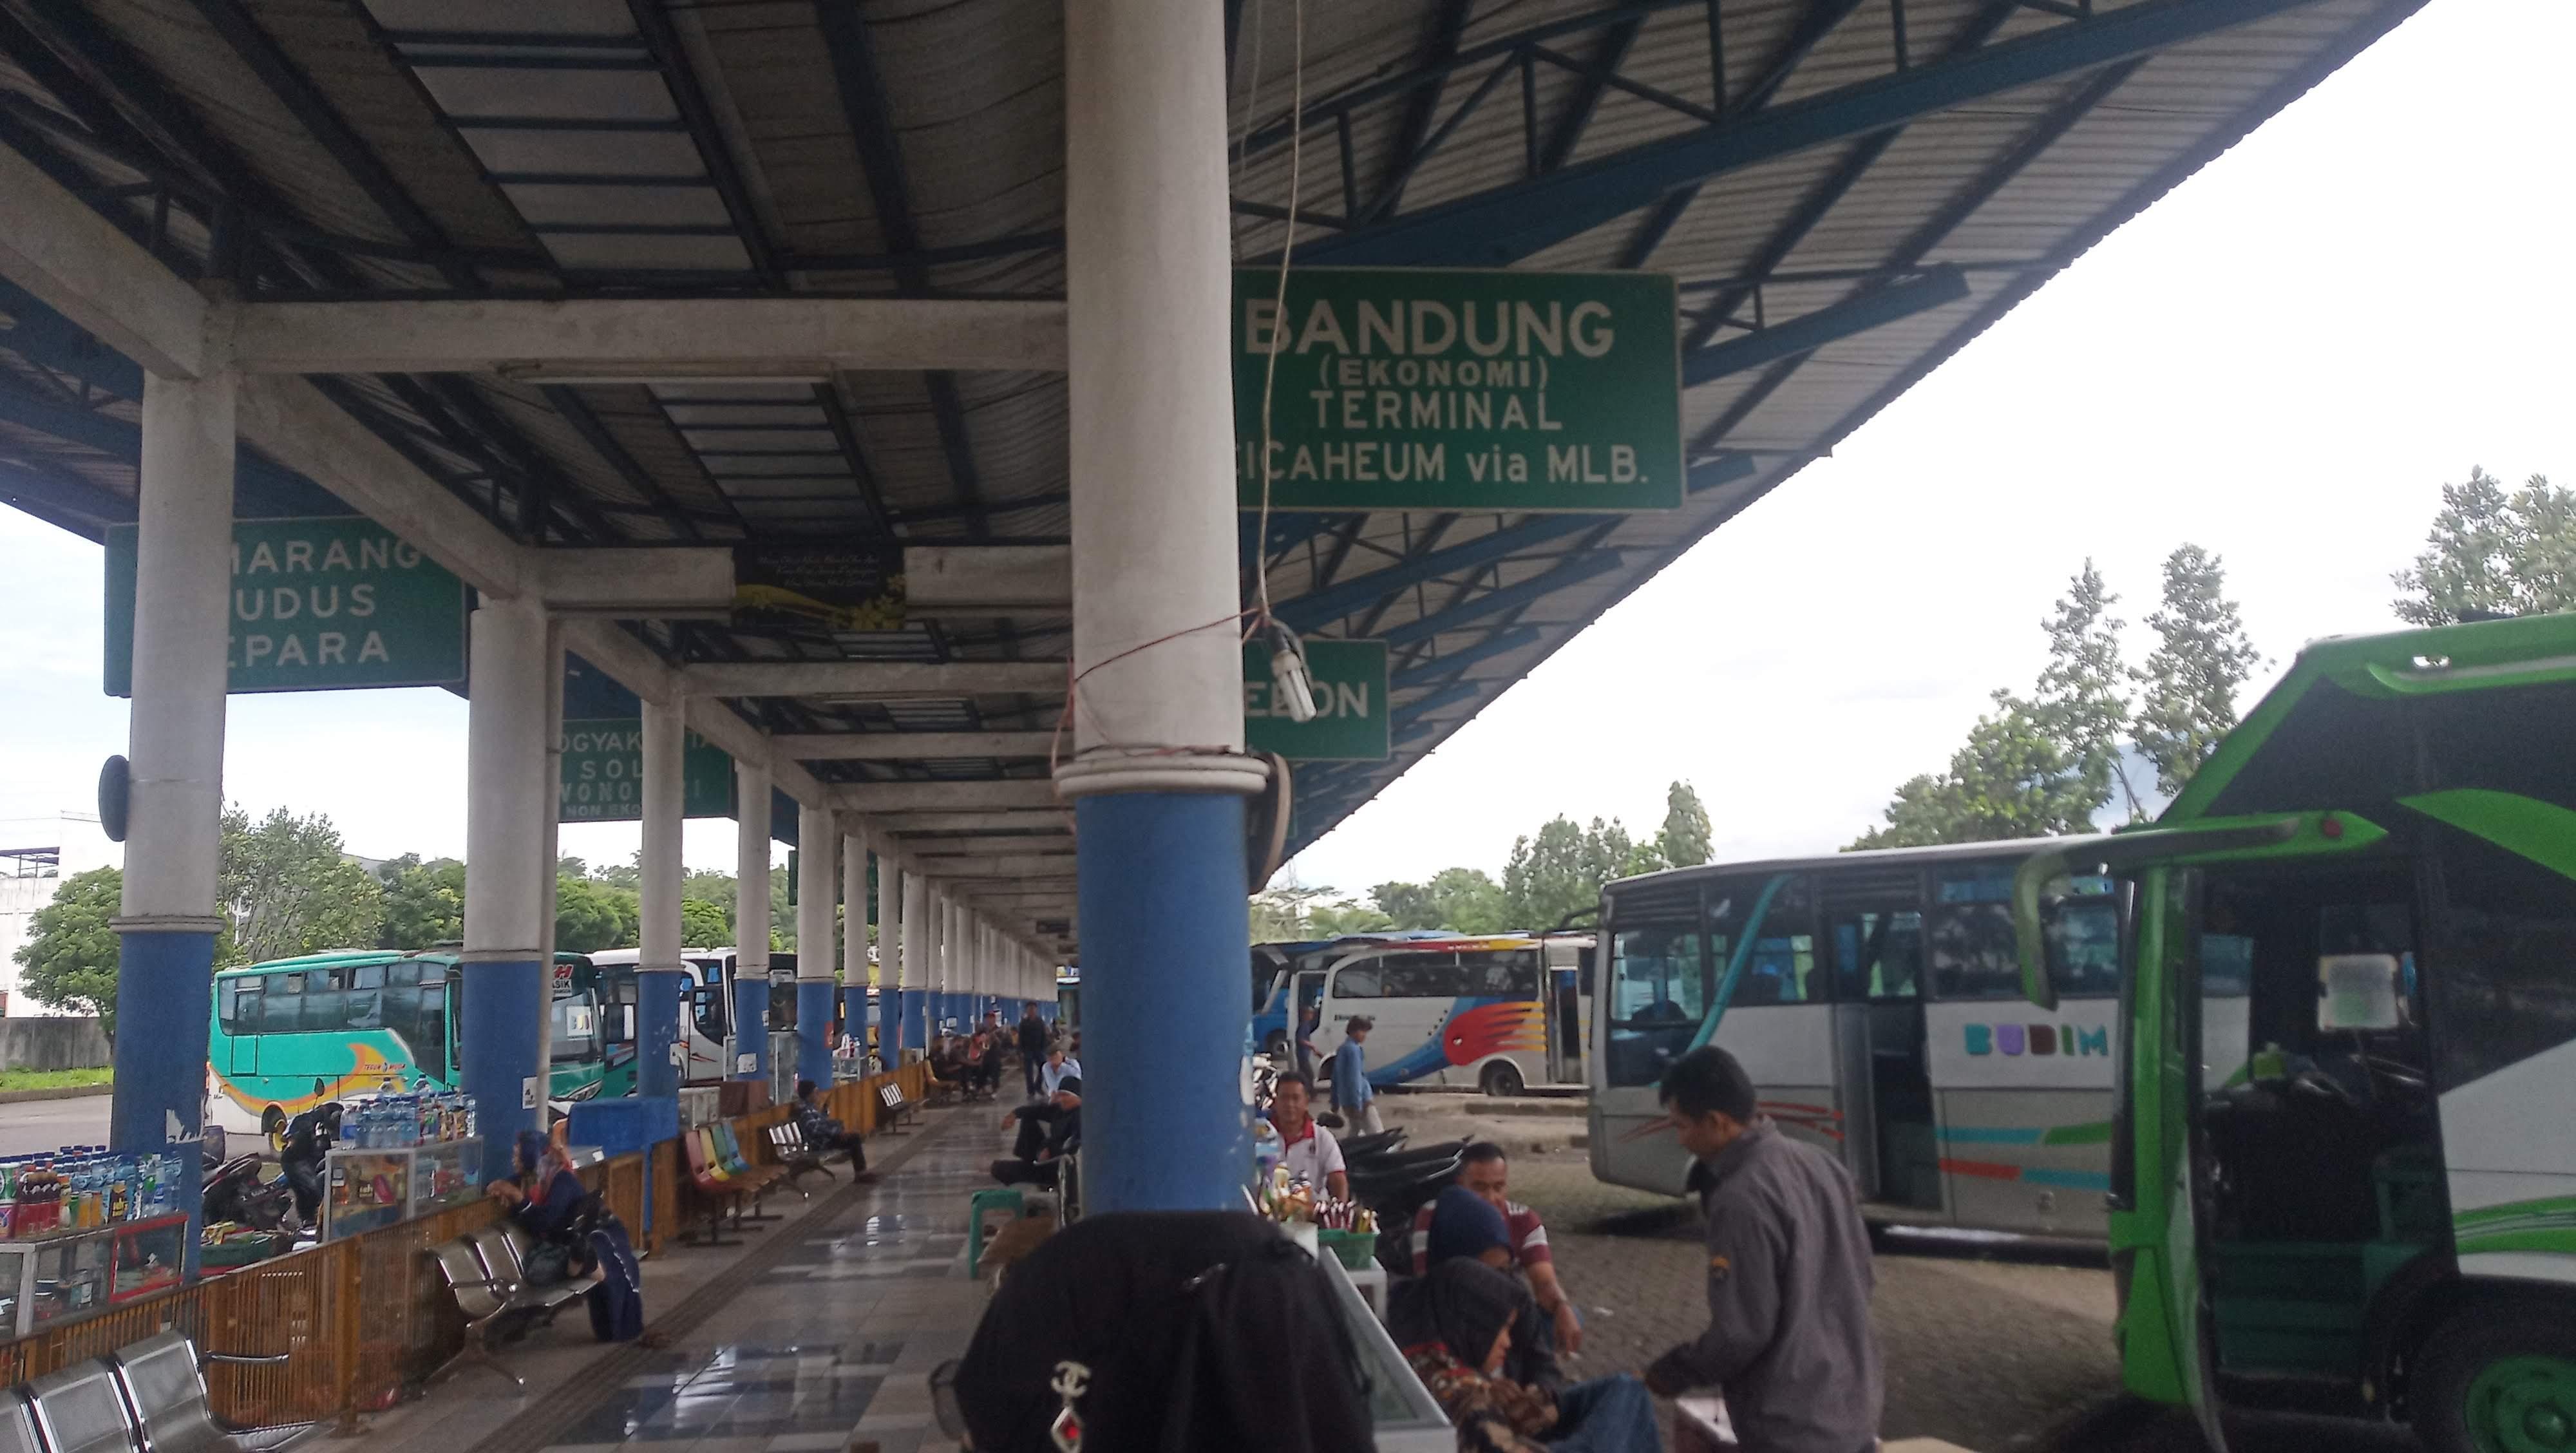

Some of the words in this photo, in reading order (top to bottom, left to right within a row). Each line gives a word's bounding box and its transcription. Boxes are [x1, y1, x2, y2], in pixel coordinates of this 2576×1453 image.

[1244, 299, 1615, 358] BANDUNG
[1319, 353, 1548, 390] (EKONOMI)
[1310, 390, 1563, 431] TERMINAL
[1236, 441, 1445, 482] ICAHEUM
[1466, 445, 1528, 483] via
[1548, 444, 1649, 484] MLB.
[236, 583, 376, 622] UDUS
[580, 759, 643, 779] SOL
[1964, 1023, 2109, 1056] BUDIM
